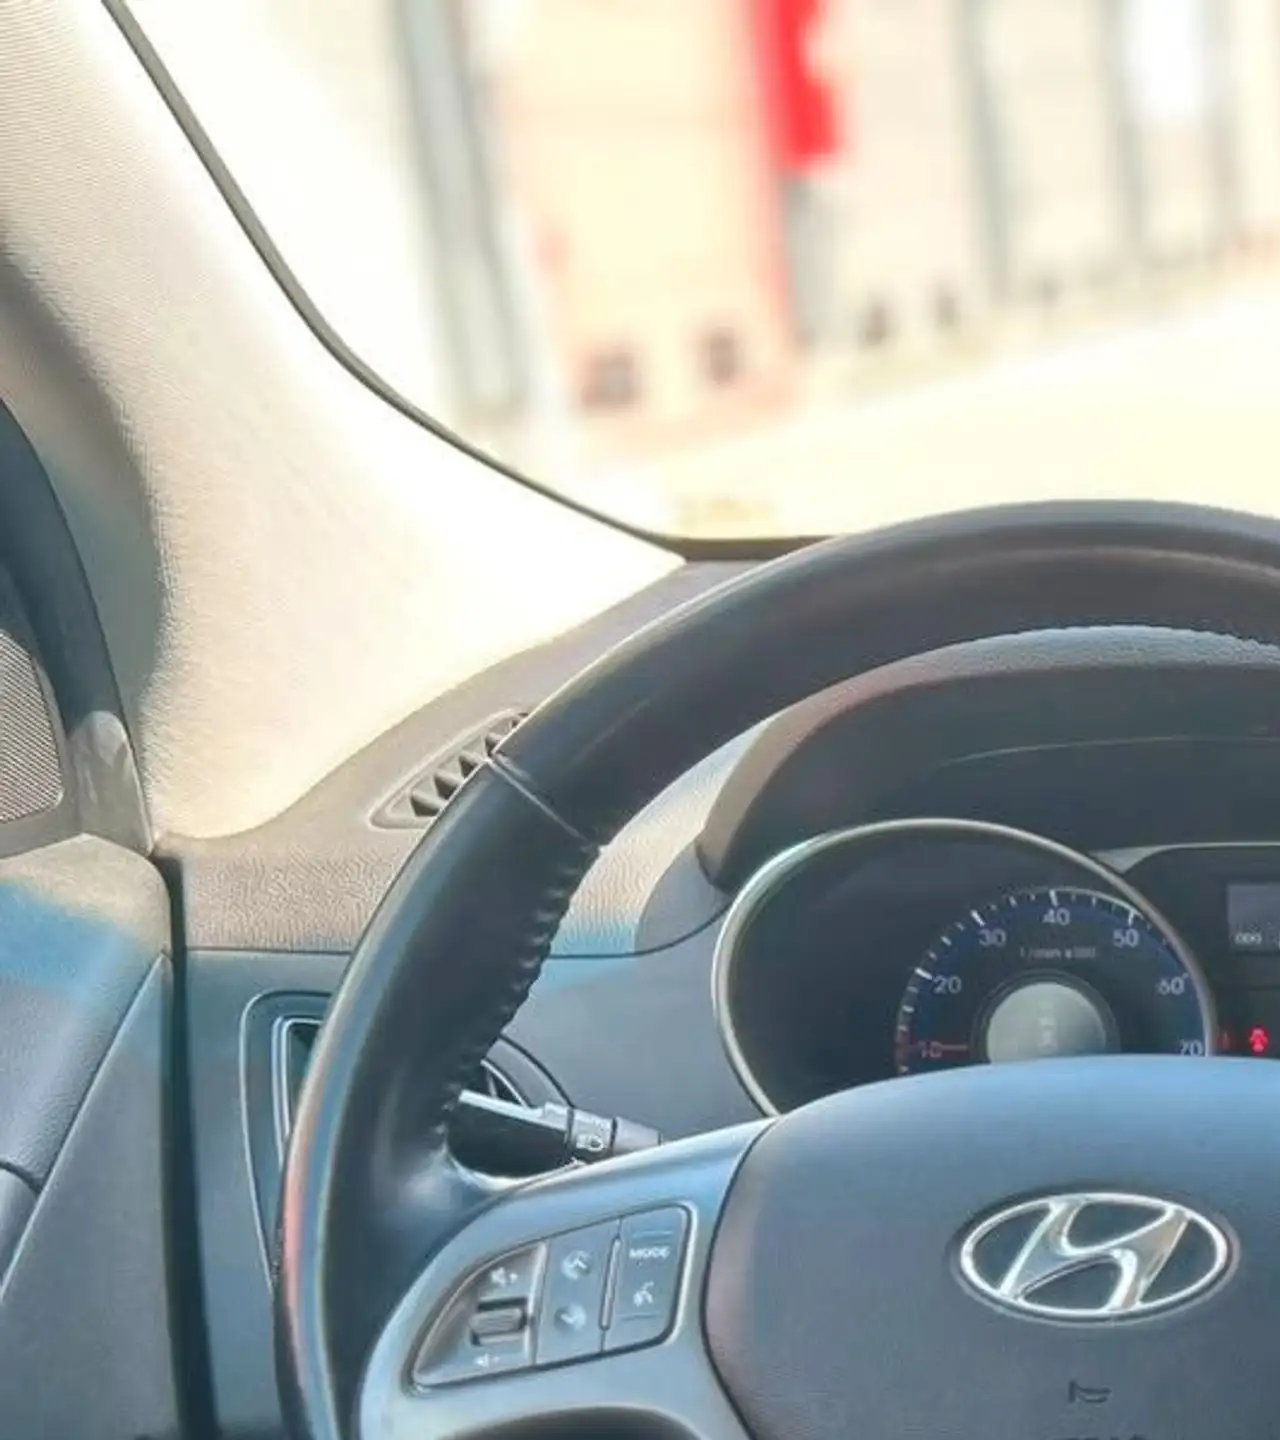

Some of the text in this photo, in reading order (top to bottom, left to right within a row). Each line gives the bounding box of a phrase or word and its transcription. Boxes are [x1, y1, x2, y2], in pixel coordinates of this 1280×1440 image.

[1041, 907, 1071, 926] 40
[978, 928, 1007, 947] 30
[1112, 928, 1140, 948] 50
[933, 976, 962, 995] 20
[1157, 979, 1185, 995] 60
